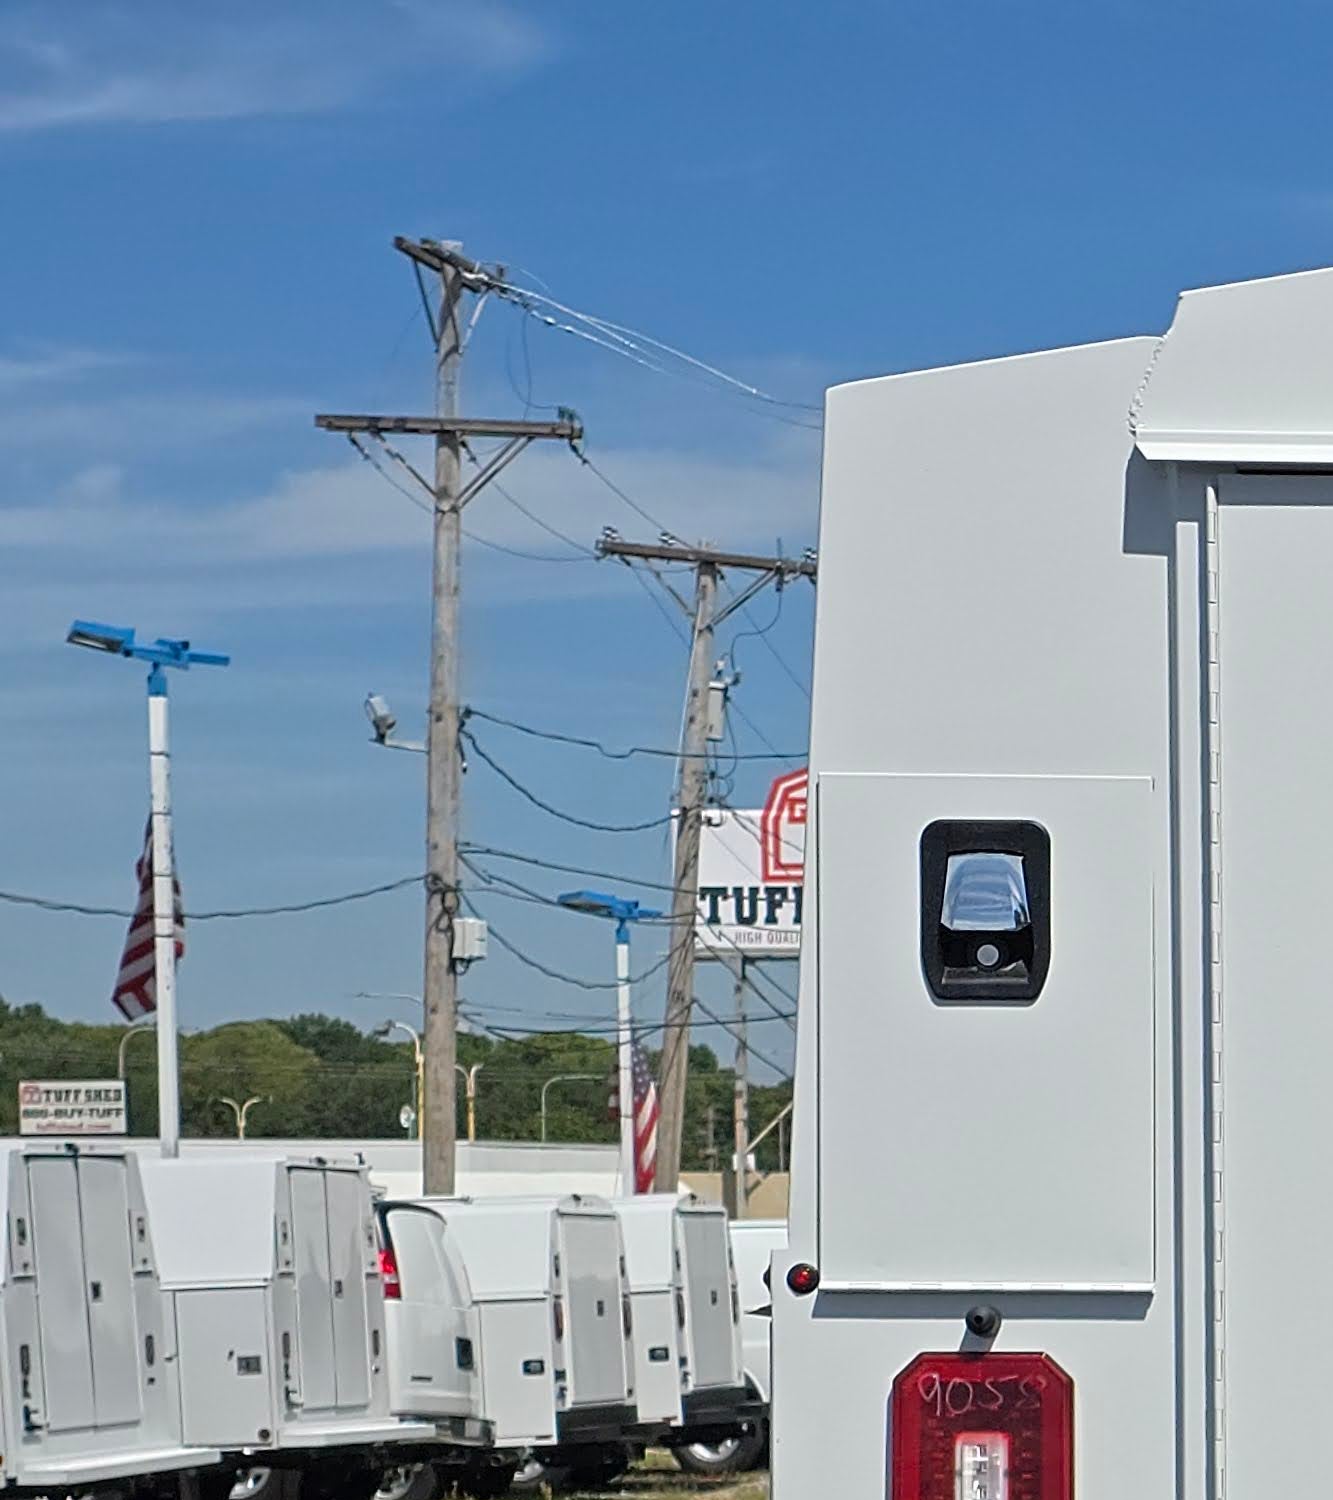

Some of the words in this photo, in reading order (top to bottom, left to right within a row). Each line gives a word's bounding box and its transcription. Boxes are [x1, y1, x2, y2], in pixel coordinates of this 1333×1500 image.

[43, 1088, 82, 1102] TUFF
[84, 1088, 122, 1102] SHED
[22, 1107, 124, 1119] -BUY-TUFF
